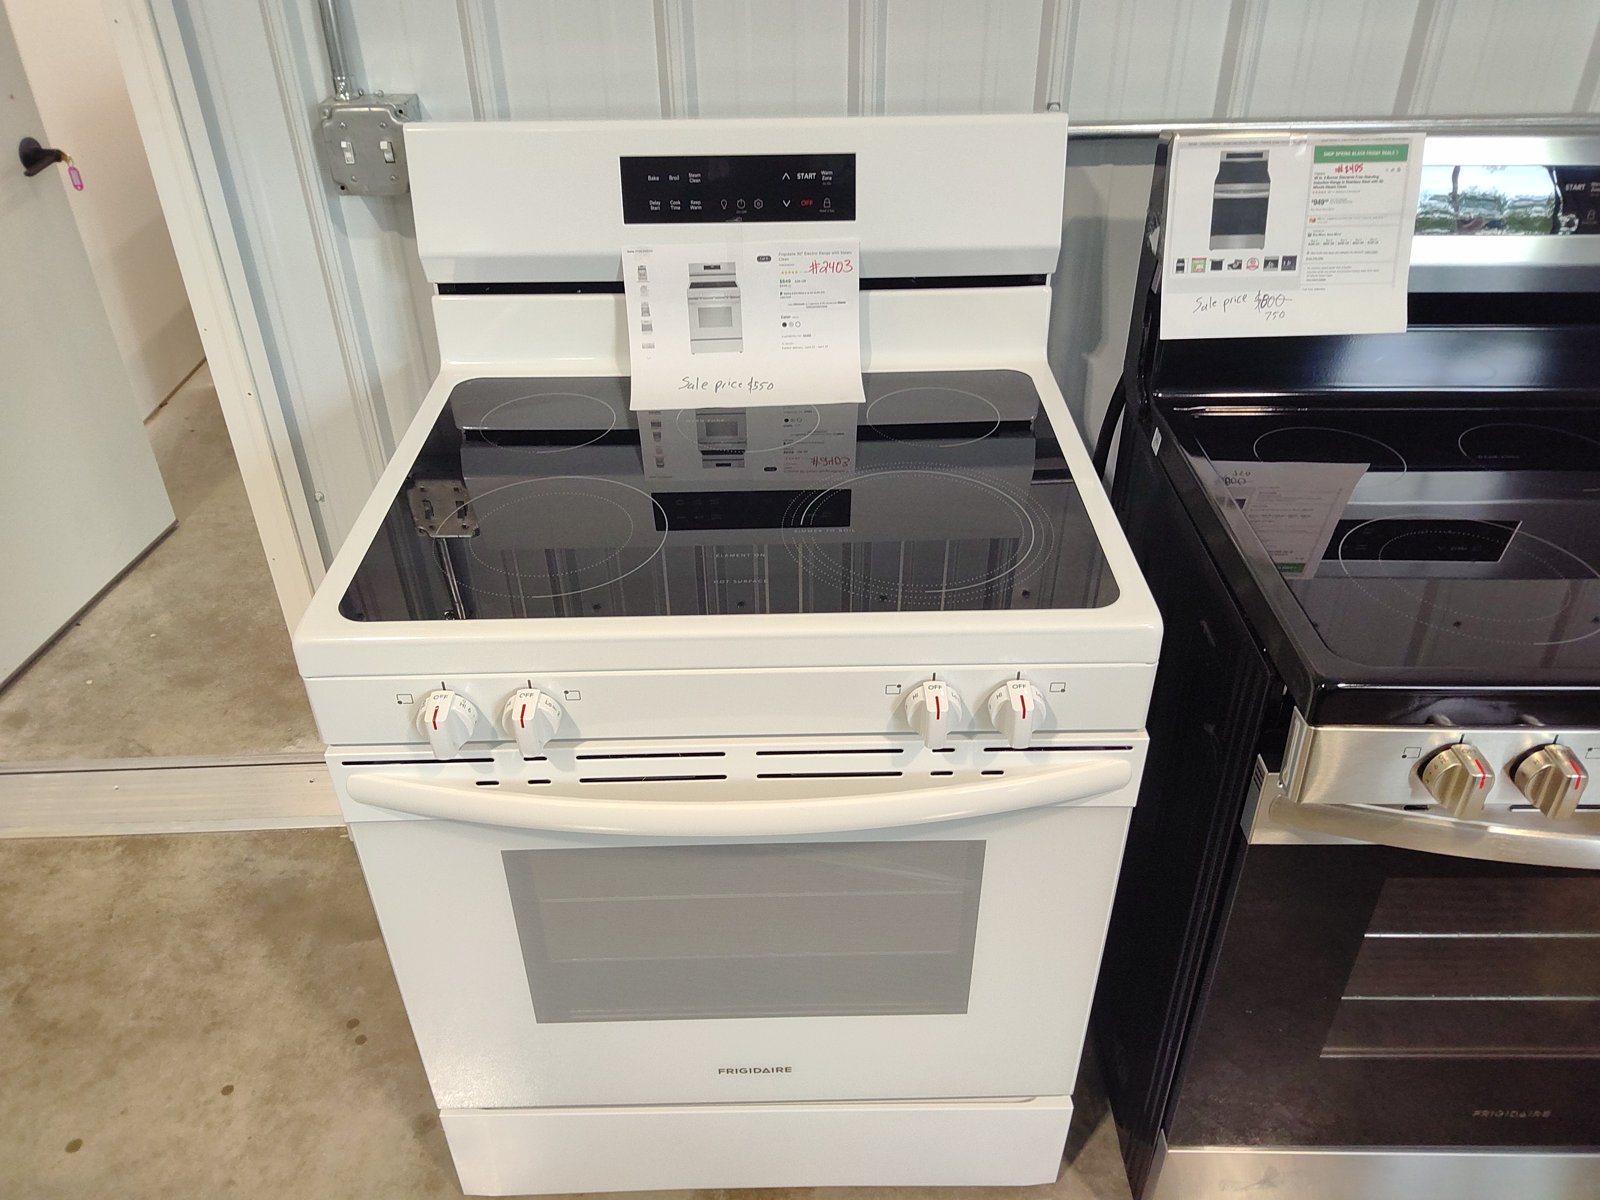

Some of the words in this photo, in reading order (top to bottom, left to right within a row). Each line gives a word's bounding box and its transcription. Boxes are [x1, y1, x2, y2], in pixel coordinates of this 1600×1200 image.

[809, 259, 853, 274] #2403
[1193, 296, 1217, 313] Sale
[1223, 293, 1248, 312] price
[1264, 310, 1286, 320] 750
[678, 376, 709, 390] Sale
[714, 378, 743, 393] price
[747, 376, 774, 394] $550
[718, 1066, 793, 1075] FRIGIDAIRE
[1472, 1109, 1552, 1118] FRIGIDAIRE
